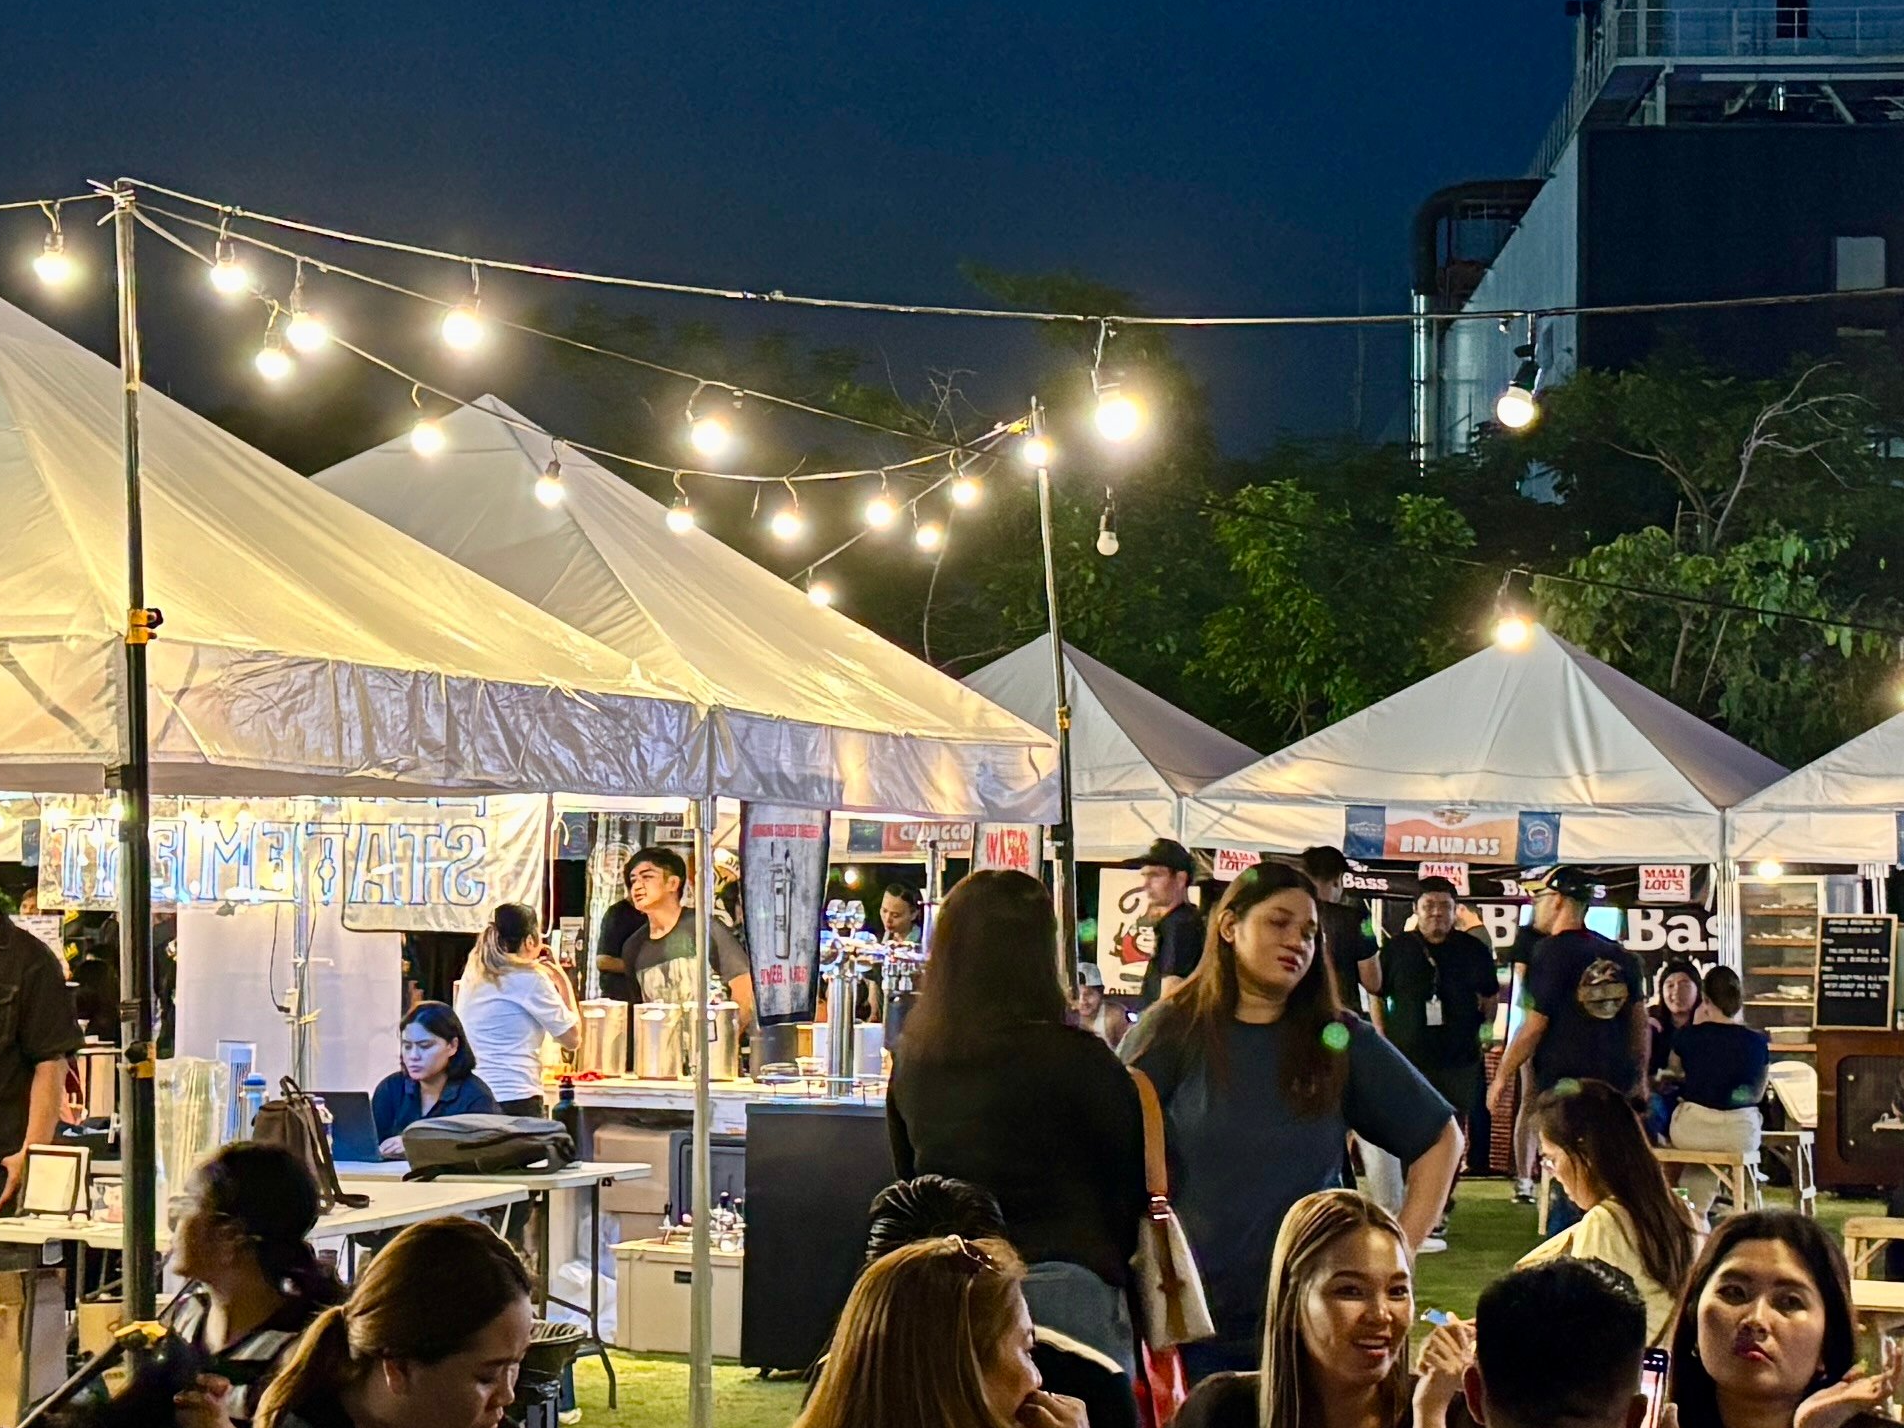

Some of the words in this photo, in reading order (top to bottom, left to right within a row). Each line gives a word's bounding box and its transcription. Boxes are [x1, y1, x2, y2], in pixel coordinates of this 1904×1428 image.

[1399, 835, 1501, 856] BRAUBASS
[1219, 860, 1249, 872] LOU
[1644, 869, 1686, 879] MAMA
